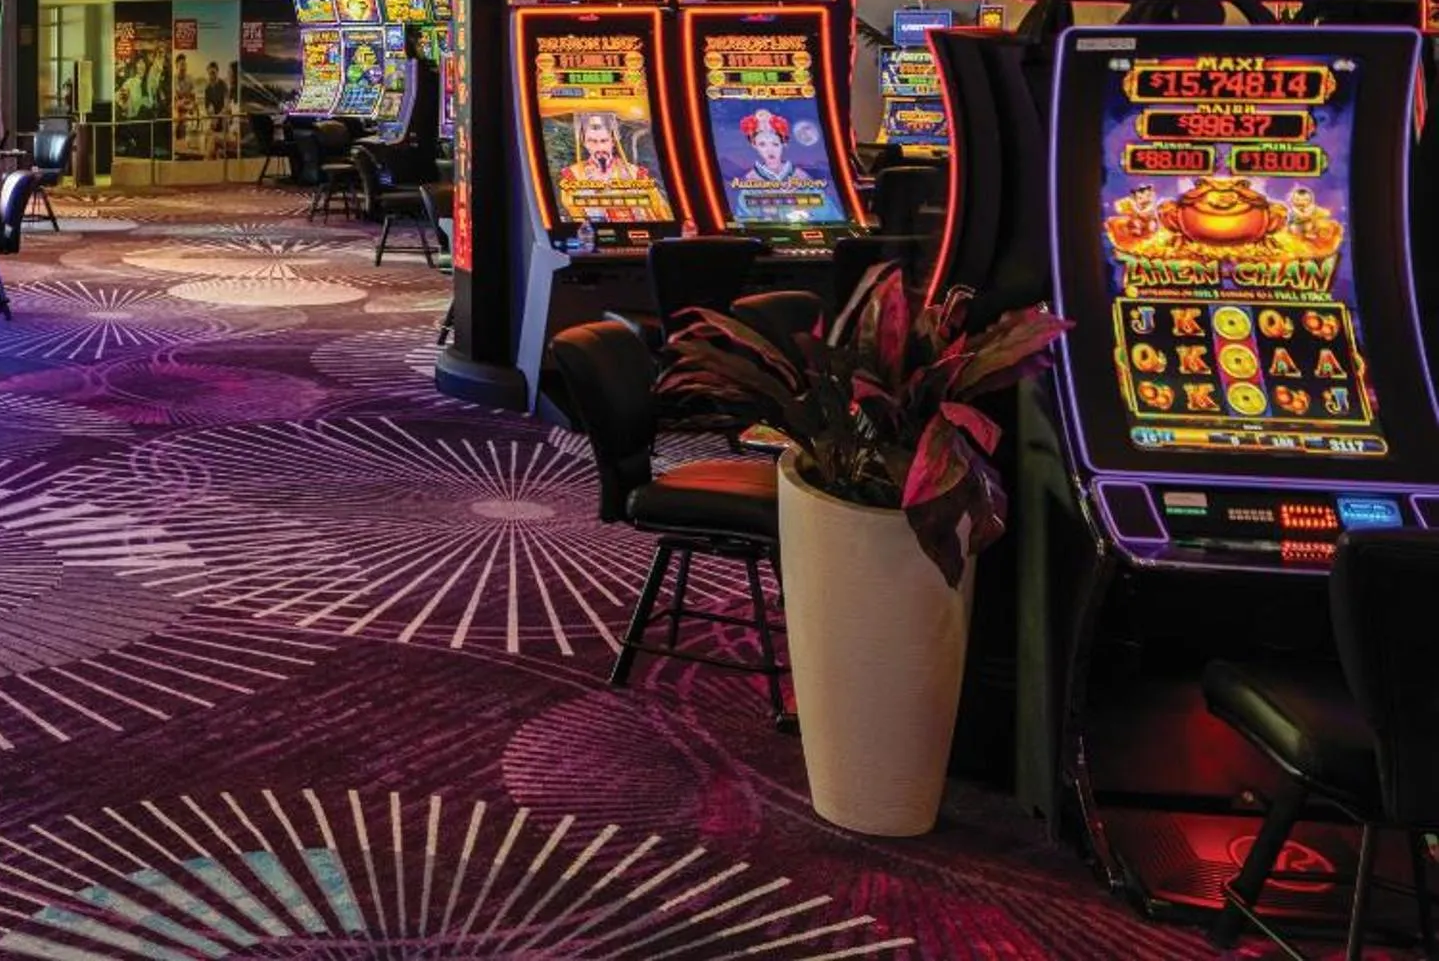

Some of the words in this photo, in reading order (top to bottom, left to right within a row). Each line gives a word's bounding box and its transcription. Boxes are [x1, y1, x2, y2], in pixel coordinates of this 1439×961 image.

[1196, 56, 1265, 71] MAXI
[1197, 104, 1256, 115] MAJOR
[1177, 114, 1273, 138] $996.37
[1136, 150, 1204, 169] $88.00
[1241, 151, 1310, 171] $18.00
[1131, 306, 1156, 335] J
[1171, 308, 1206, 337] K
[1176, 345, 1212, 375] K
[1269, 347, 1302, 378] A
[1314, 348, 1348, 379] A
[1183, 384, 1221, 412] K
[1323, 386, 1350, 416] J
